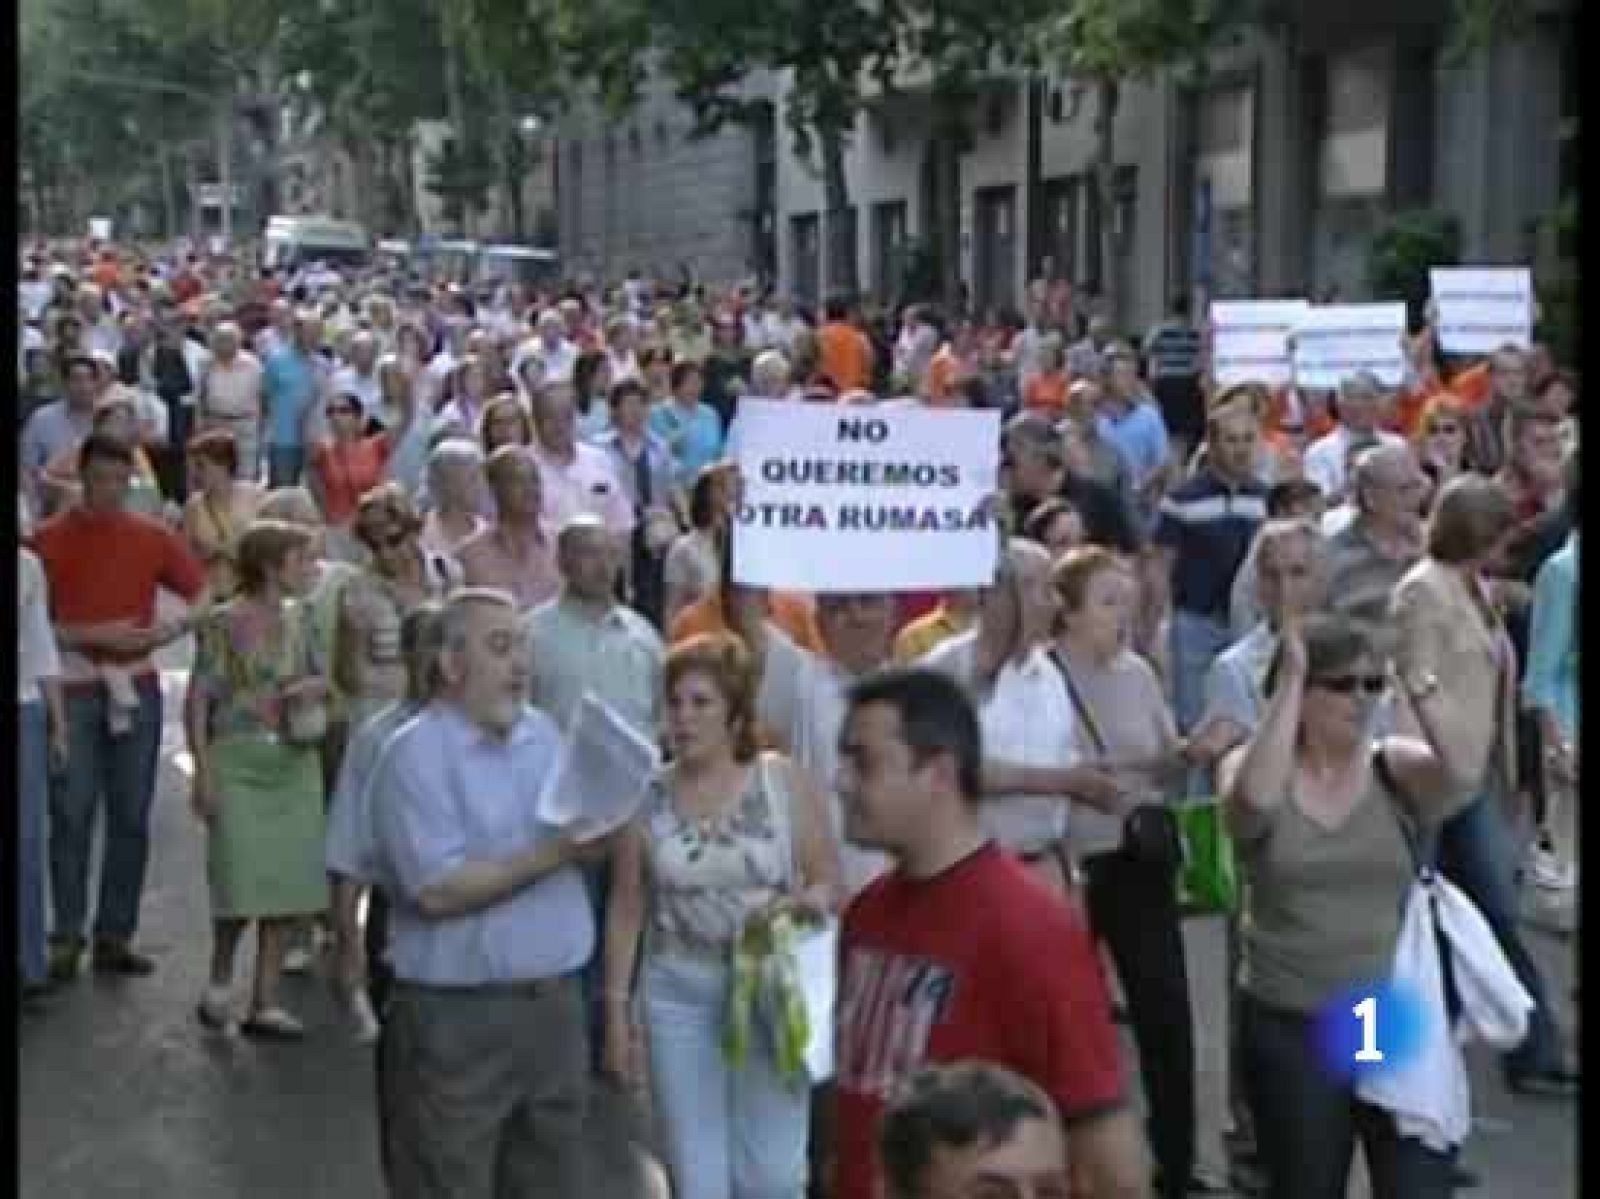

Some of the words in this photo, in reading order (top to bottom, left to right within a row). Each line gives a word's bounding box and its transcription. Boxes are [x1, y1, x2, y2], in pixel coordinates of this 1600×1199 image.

[837, 418, 889, 442] NO
[762, 459, 960, 487] QUEREMOS
[837, 504, 988, 531] RUMASA
